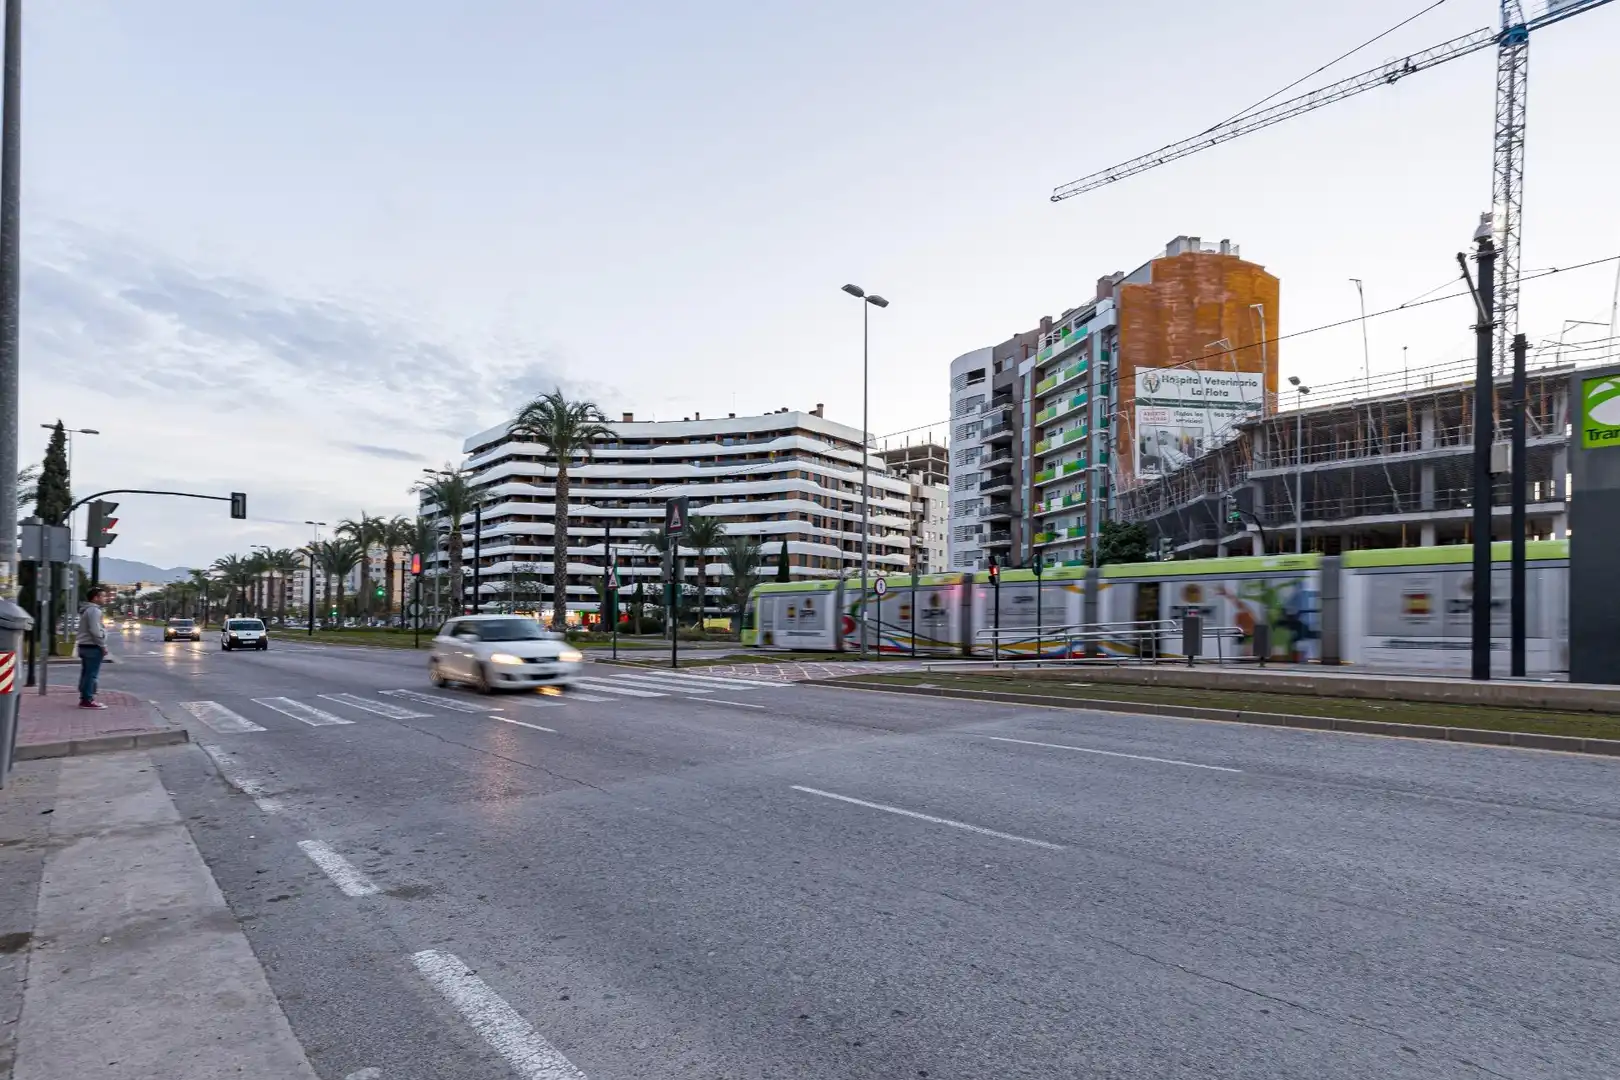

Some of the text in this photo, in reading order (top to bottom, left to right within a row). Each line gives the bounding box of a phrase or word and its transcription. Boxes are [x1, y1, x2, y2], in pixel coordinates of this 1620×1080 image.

[1162, 375, 1258, 387] Hospital Veterinario
[1191, 388, 1229, 397] La Flota
